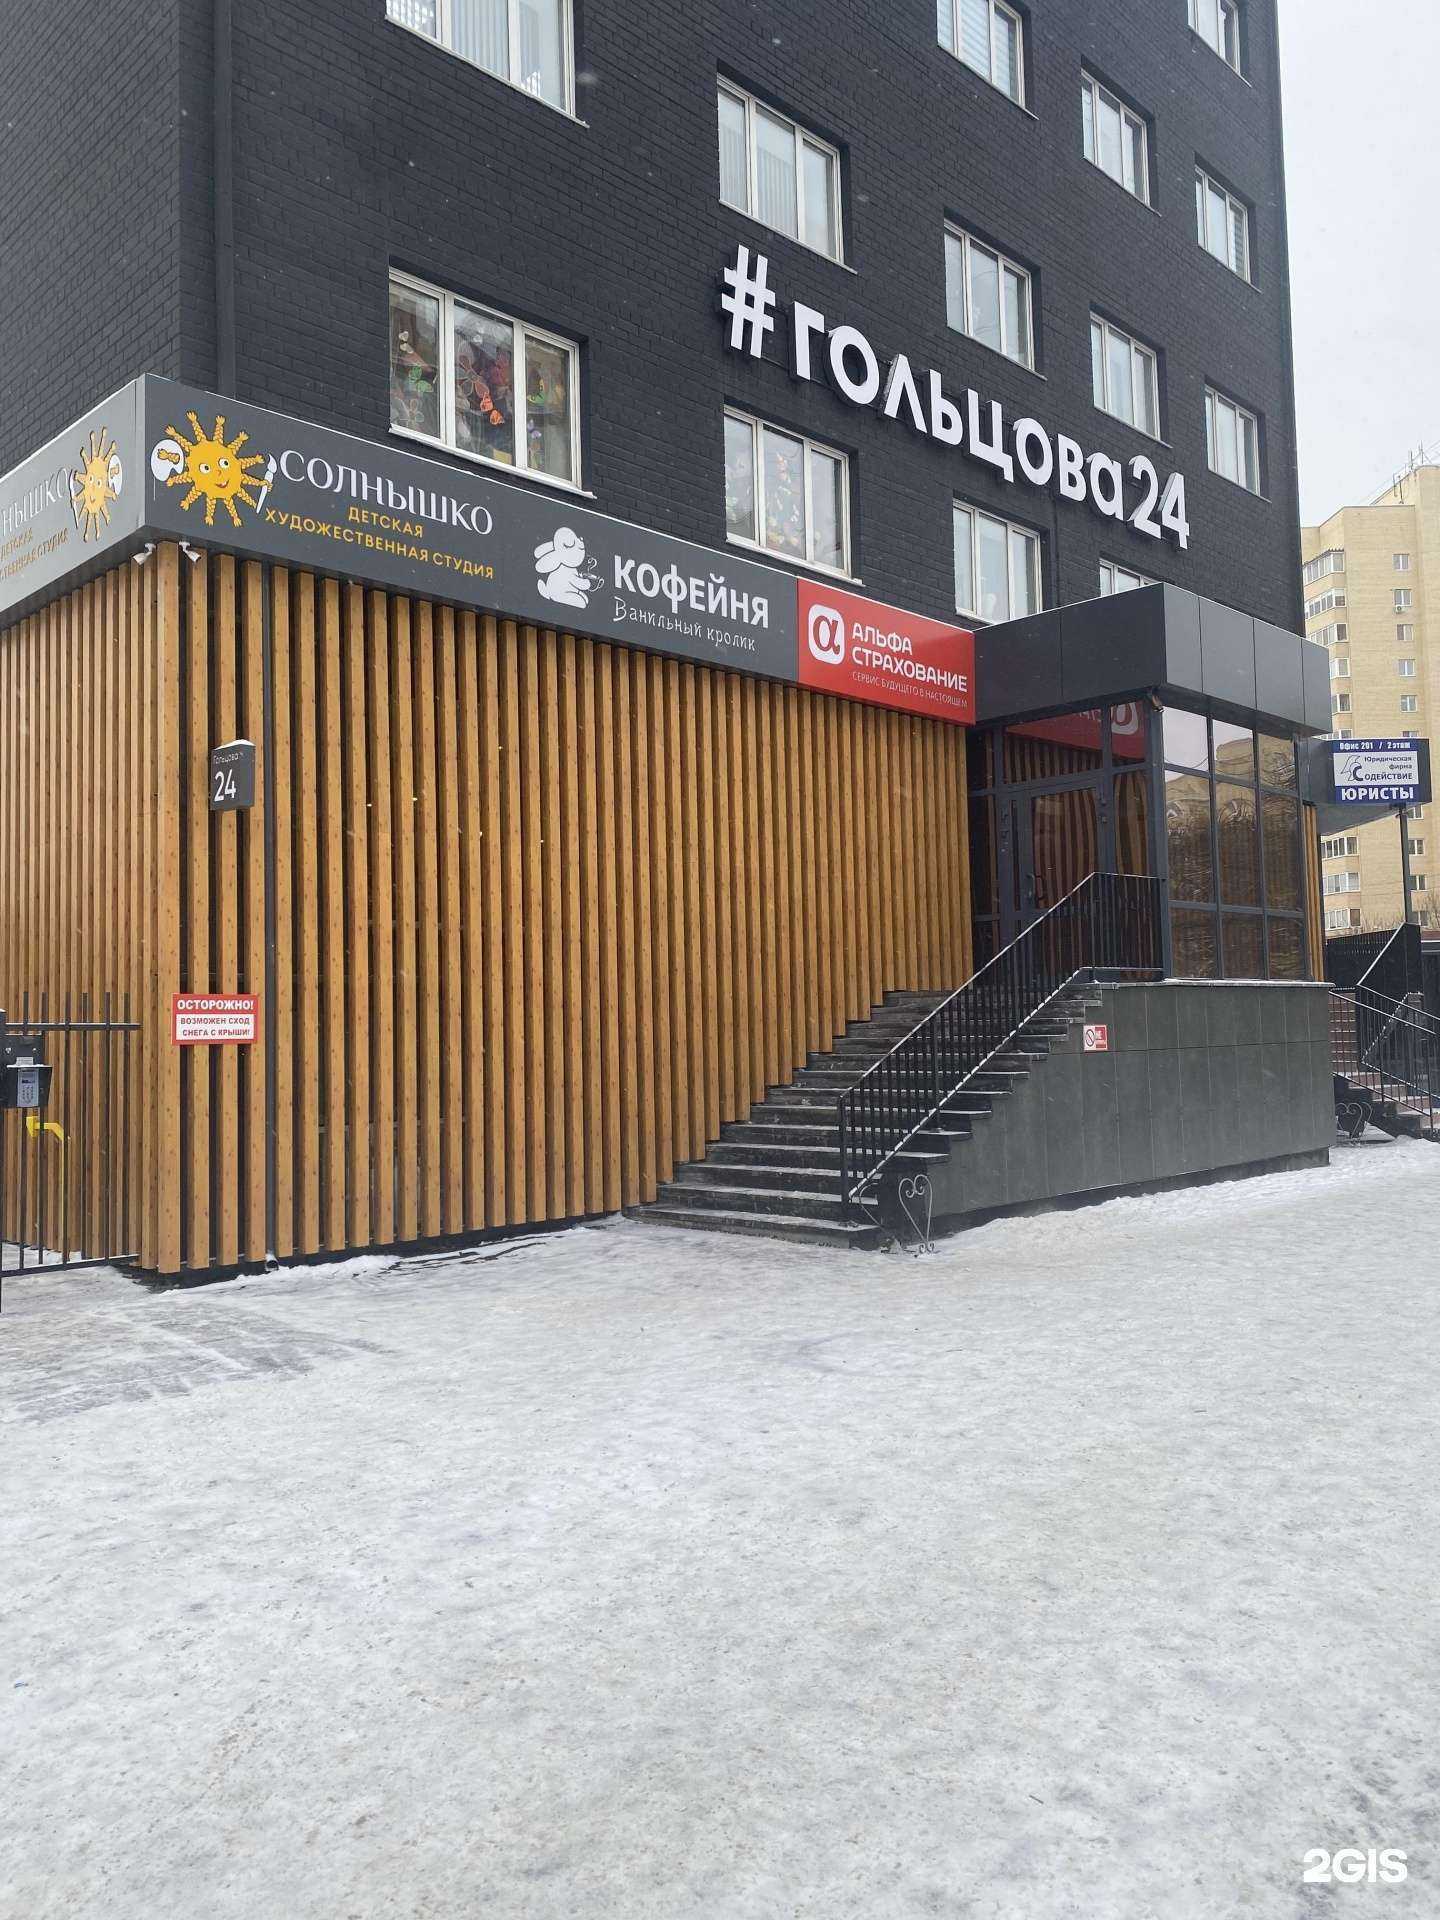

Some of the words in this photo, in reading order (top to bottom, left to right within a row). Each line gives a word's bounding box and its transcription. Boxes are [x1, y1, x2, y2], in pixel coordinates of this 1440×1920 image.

[279, 449, 493, 535] СОЛНЫШКО
[348, 506, 424, 539] ДЕТСКАЯ
[265, 508, 429, 562] ХУДОЖЕСТВЕННАЯ
[432, 552, 494, 580] СТУДИЯ
[614, 554, 769, 629] КОФЕЙНЯ
[613, 596, 702, 639] Ванильный
[707, 626, 755, 652] кролик
[852, 622, 913, 656] АЛЬФА
[852, 646, 968, 693] СТРАХОВАНИЕ
[852, 671, 881, 687] СЕРВИС
[881, 678, 919, 697] БУДУЩЕГО
[214, 768, 237, 802] 24
[1341, 786, 1414, 801] ЮРИСТЫ
[177, 999, 254, 1010] ОСТОРОЖНО!
[180, 1017, 226, 1025] ВОЗМОЖЕН
[228, 1017, 250, 1026] СХОД
[182, 1029, 209, 1037] СНЕГА
[218, 1029, 250, 1037] КРЫШИ!
